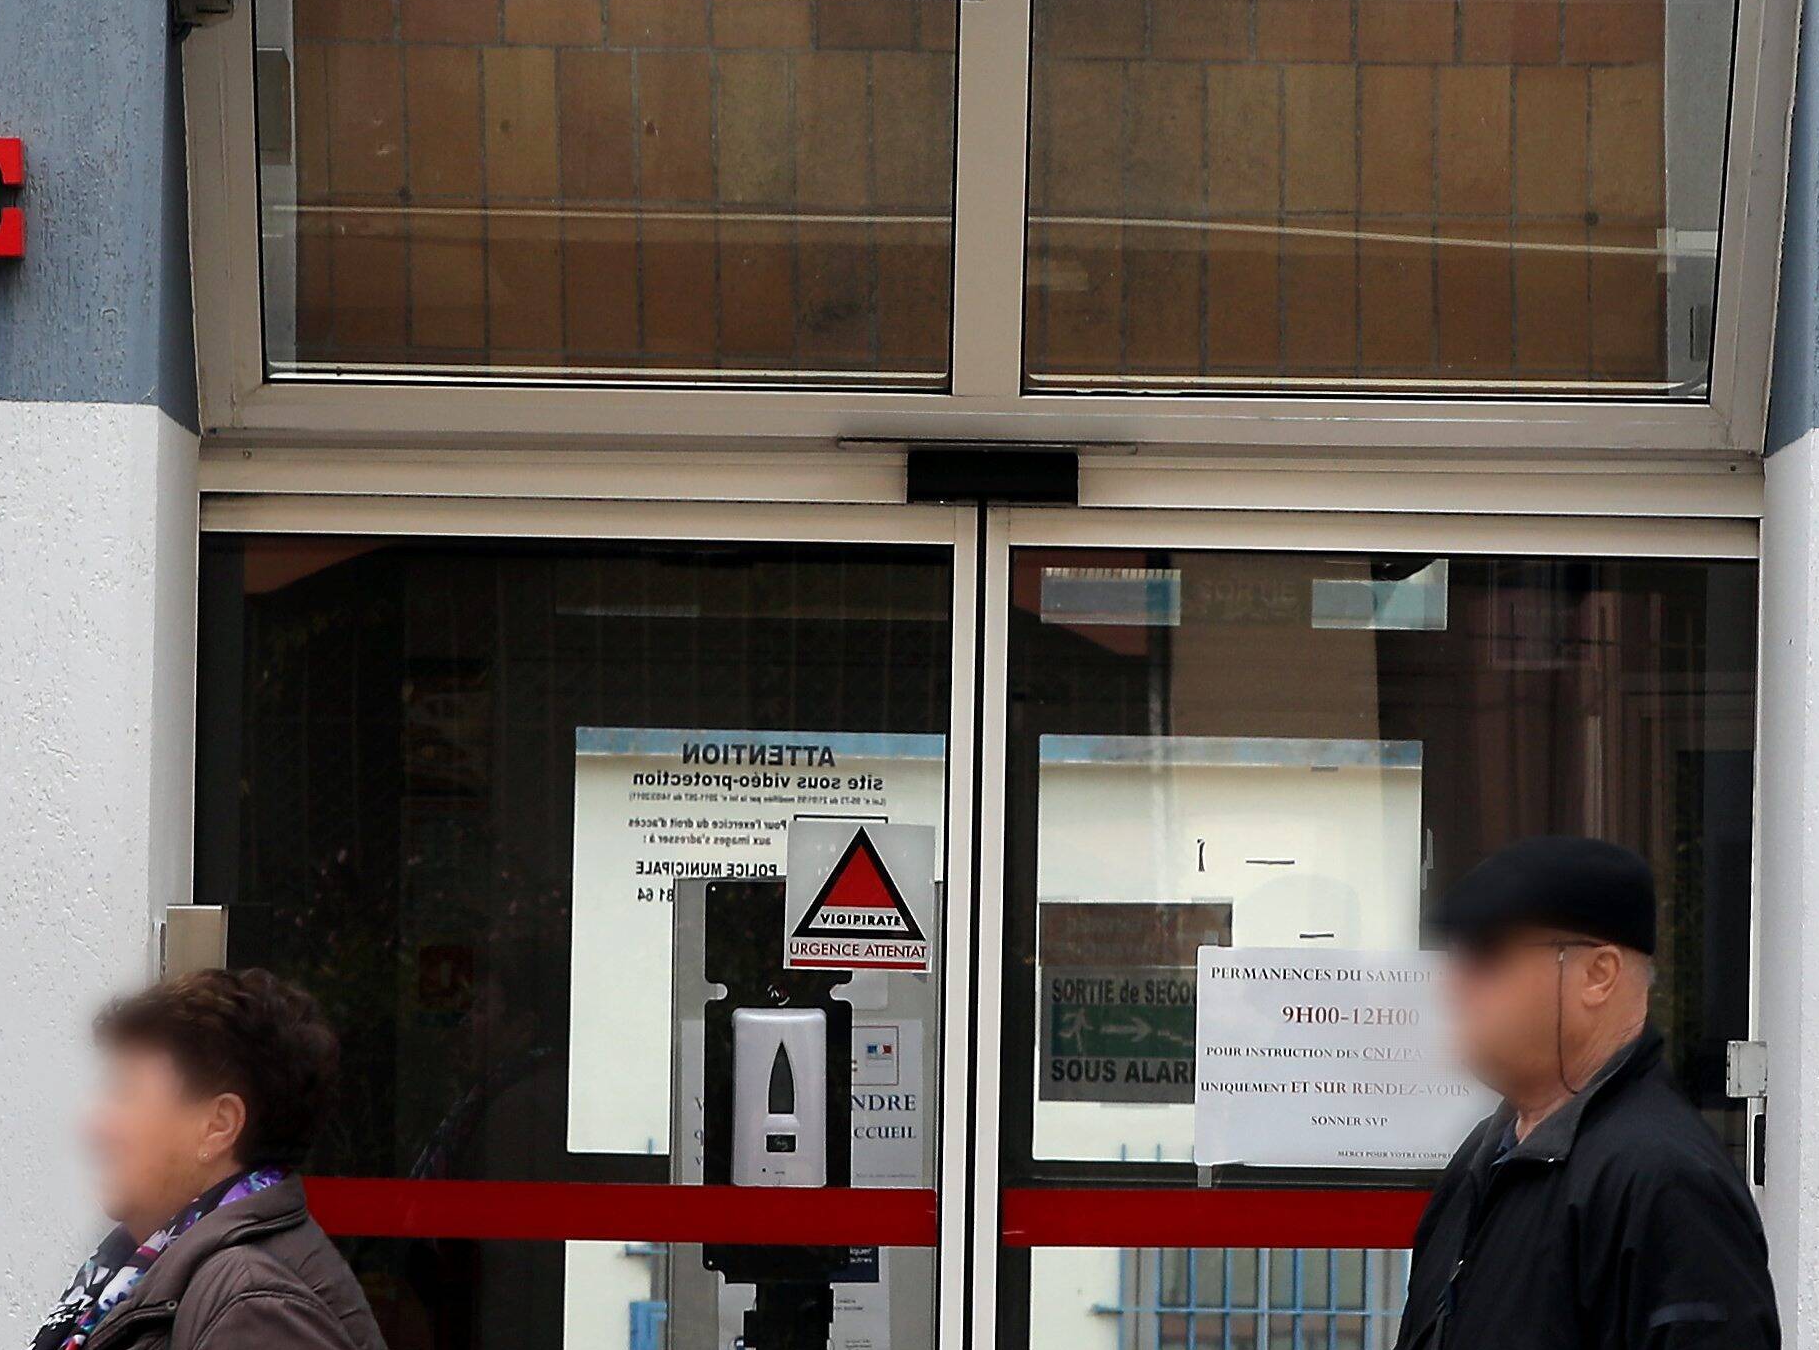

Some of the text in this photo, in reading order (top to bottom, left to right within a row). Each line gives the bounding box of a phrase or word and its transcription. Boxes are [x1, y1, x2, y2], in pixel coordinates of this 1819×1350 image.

[820, 913, 901, 926] VIGIPIRATE
[789, 942, 927, 958] URGENCE ATTENTAT
[1210, 966, 1332, 983] PERMANENCES
[1336, 968, 1361, 982] DU
[1051, 978, 1197, 1004] SORTIE de SECO
[1281, 1006, 1420, 1027] 9H00-12H00
[1206, 1046, 1242, 1059] POUR
[1245, 1046, 1333, 1059] INSTRUCTION
[1336, 1049, 1359, 1060] DES
[1051, 1058, 1195, 1084] SOUS ALAR
[1200, 1080, 1470, 1098] UNIQUEMENT ET SUR RENDEZ-VOUS
[1311, 1114, 1389, 1128] SONNER SVP
[853, 1125, 917, 1140] CCUEIL
